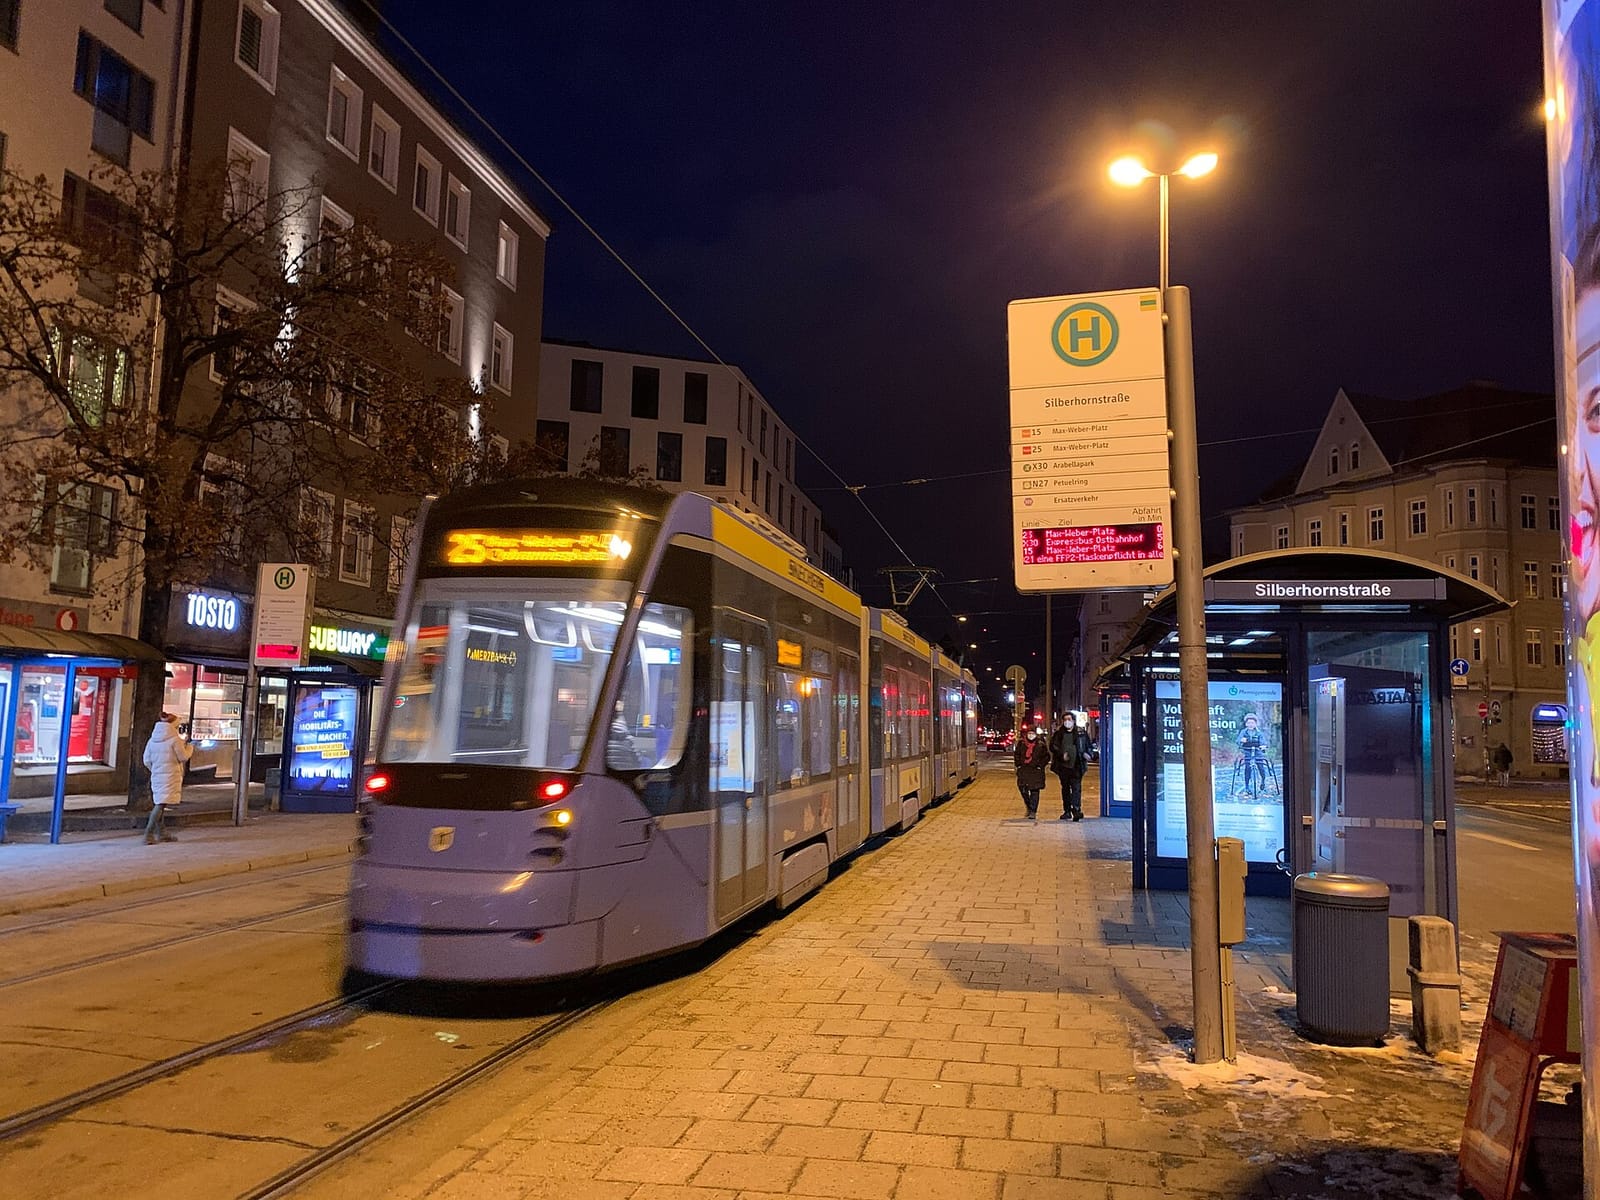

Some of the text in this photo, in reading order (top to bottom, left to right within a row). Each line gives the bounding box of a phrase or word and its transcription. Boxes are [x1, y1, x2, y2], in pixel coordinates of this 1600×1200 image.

[1070, 316, 1100, 352] H
[1045, 392, 1130, 408] Silberhornstraße
[1032, 424, 1108, 436] 15 Max-Weber-Platz
[1053, 442, 1109, 452] Max-Weber-Platz
[1032, 460, 1094, 470] X30 Arabellapark
[1054, 478, 1088, 487] Petuelring
[1054, 496, 1099, 504] Ersatzverkehr
[1022, 518, 1072, 528] Linie Ziel
[1022, 524, 1162, 539] 25 Max-Weber-Platz 0
[1046, 536, 1094, 546] Expressbus
[1096, 534, 1144, 544] Ostbahnhof
[1046, 544, 1116, 554] Max-Weber-Platz
[1157, 542, 1163, 550] 6
[1037, 554, 1054, 562] eine
[1056, 550, 1136, 562] FFP2-Maskenpflicht
[280, 572, 290, 584] H
[1255, 583, 1391, 598] Silberhornstraße
[187, 593, 236, 630] TOSTO
[309, 626, 373, 656] SUBWAY
[314, 710, 326, 719] DIE
[1163, 716, 1181, 728] für
[1164, 728, 1174, 740] in
